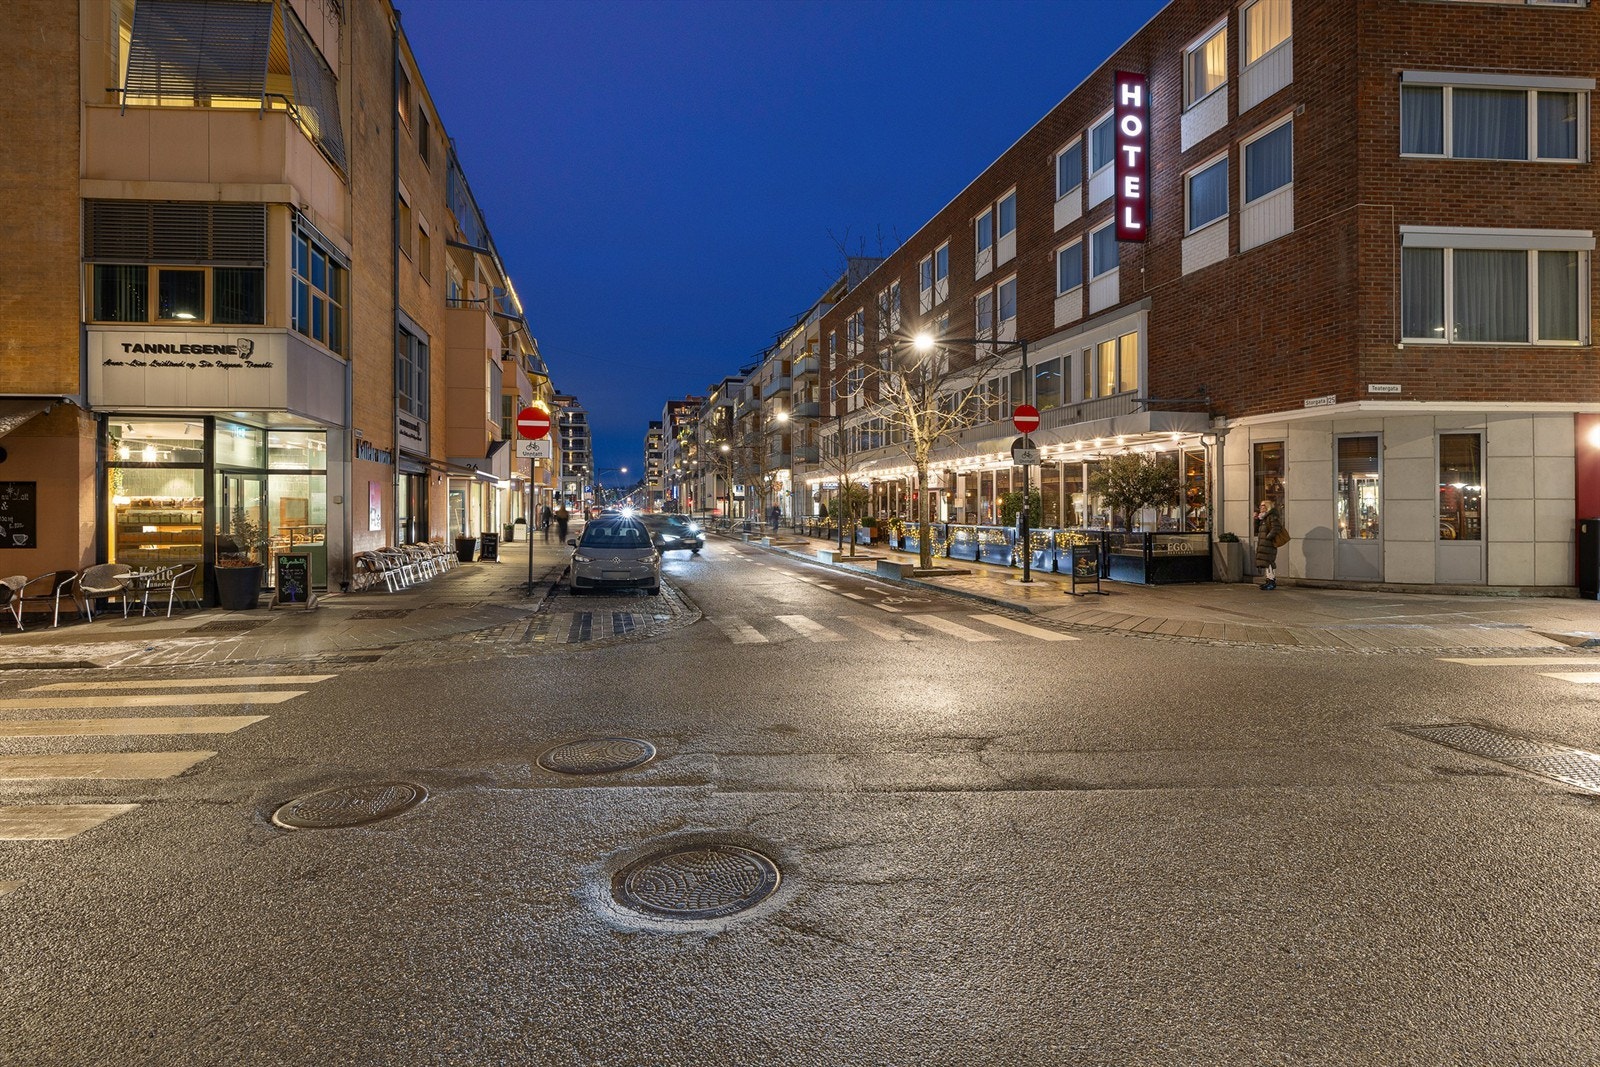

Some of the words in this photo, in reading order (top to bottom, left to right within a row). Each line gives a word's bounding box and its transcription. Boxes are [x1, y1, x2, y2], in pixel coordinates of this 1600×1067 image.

[1121, 83, 1143, 229] HOTEL
[121, 343, 238, 355] TANNLEGENE
[1305, 398, 1326, 406] Storgata
[1328, 396, 1336, 404] 25
[1167, 543, 1194, 551] EGON
[139, 566, 173, 580] Kaffe
